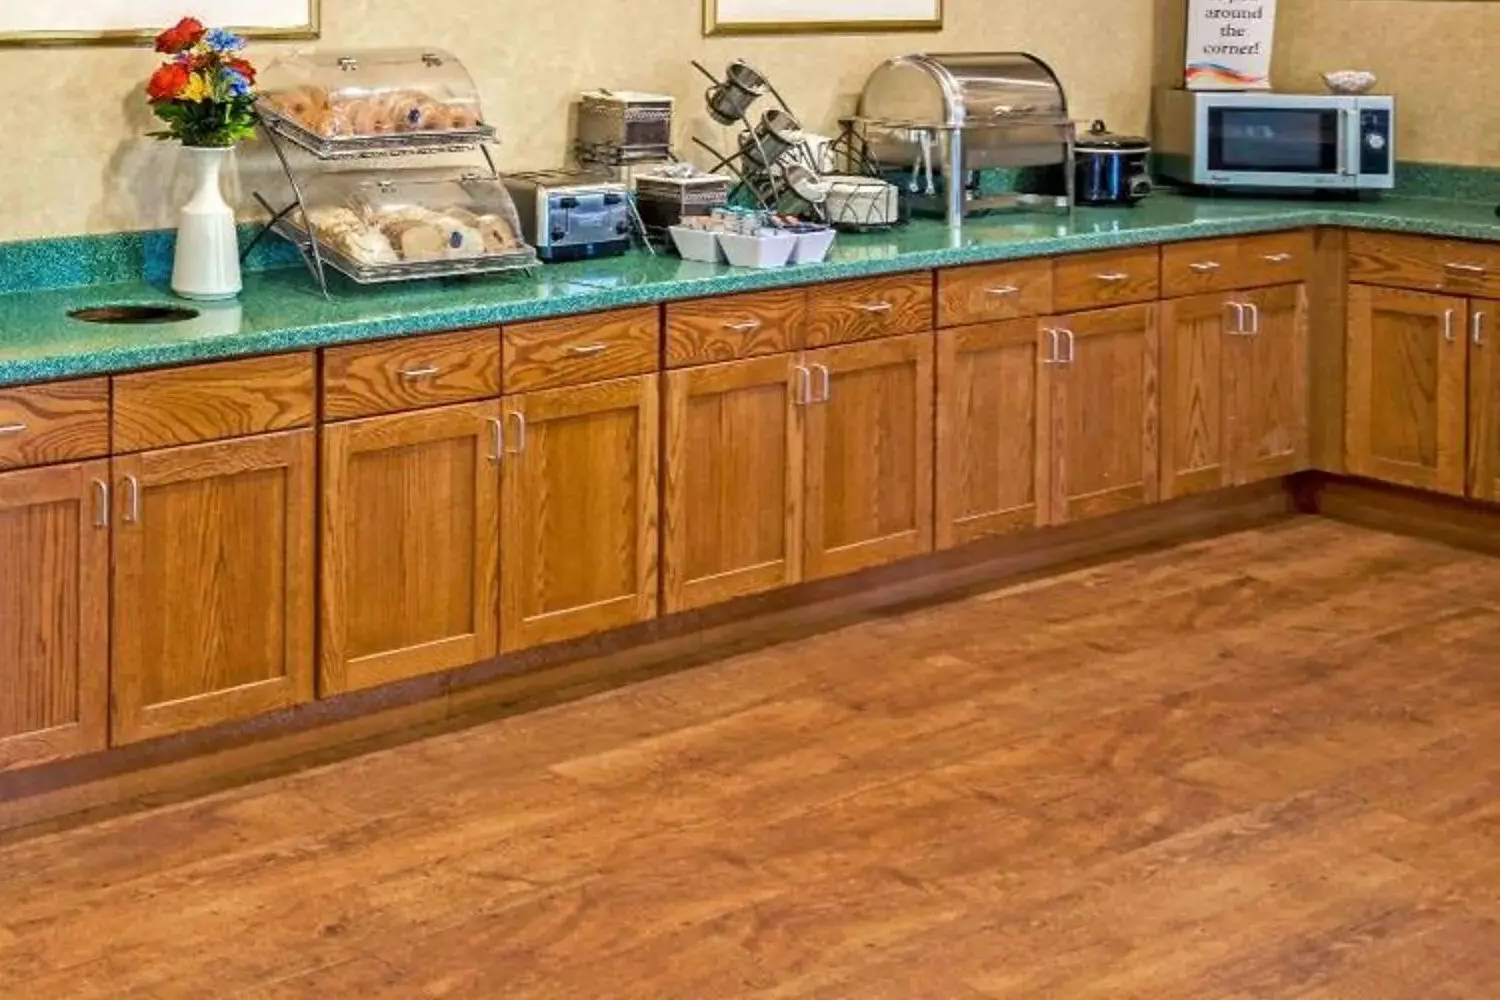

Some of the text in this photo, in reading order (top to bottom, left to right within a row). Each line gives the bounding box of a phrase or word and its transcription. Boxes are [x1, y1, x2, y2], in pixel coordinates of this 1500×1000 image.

[1203, 5, 1263, 19] around
[1219, 22, 1246, 37] the
[1203, 41, 1261, 56] corner!
